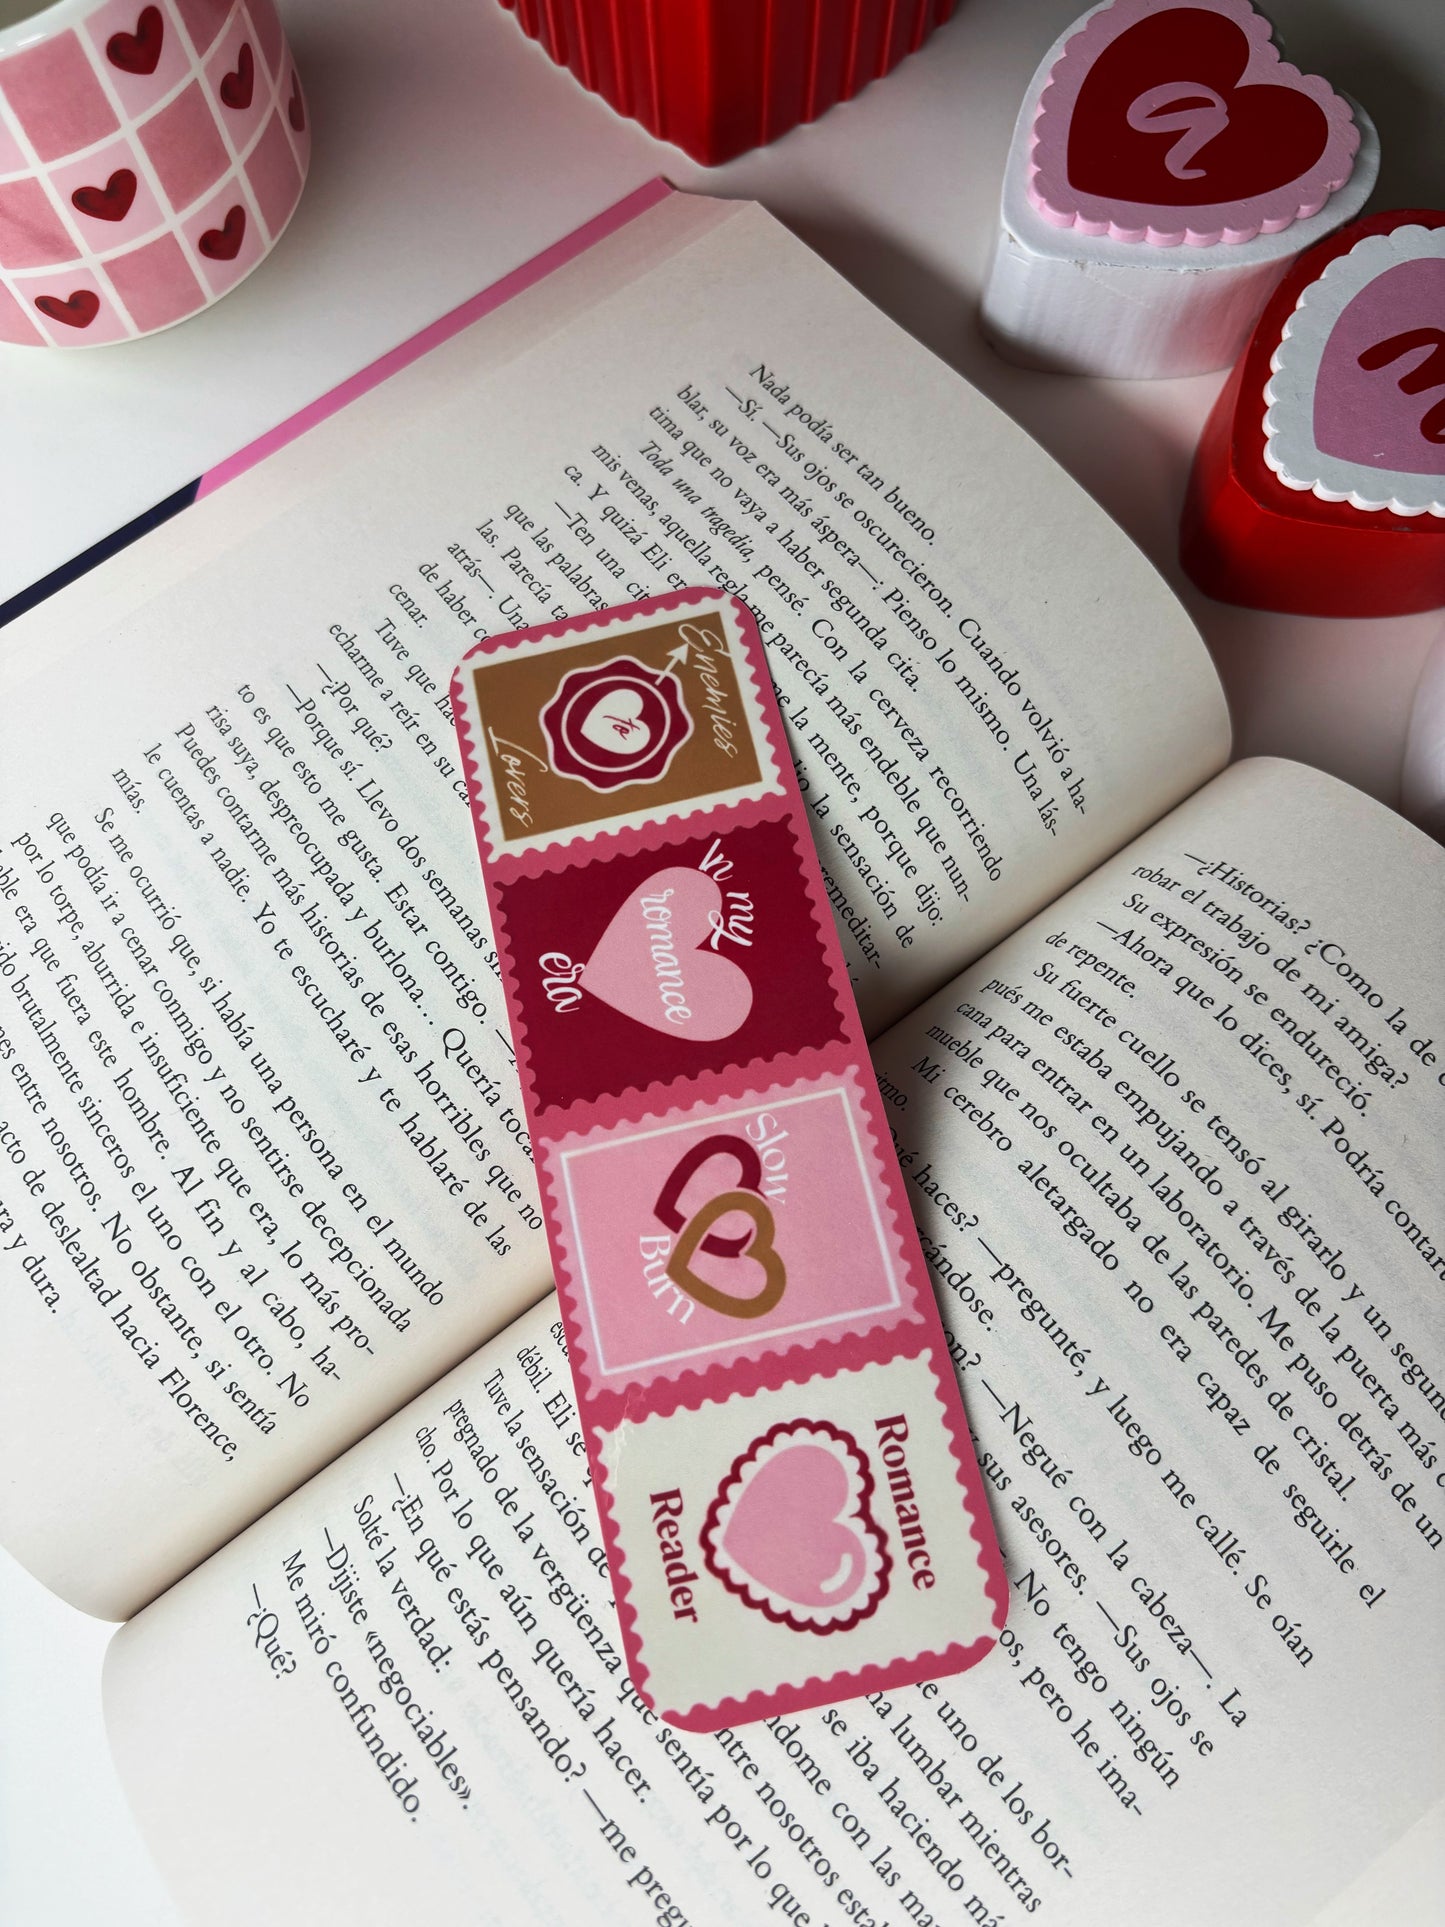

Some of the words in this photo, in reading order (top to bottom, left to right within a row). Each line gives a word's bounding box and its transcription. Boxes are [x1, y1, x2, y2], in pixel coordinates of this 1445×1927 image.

[1126, 81, 1230, 180] a
[747, 364, 791, 407] Nada
[782, 403, 833, 445] podía
[830, 442, 859, 466] ser
[855, 464, 885, 493] tan
[882, 485, 935, 547] bueno.
[387, 584, 428, 630] cenar.
[638, 440, 674, 478] Toda
[670, 478, 702, 506] una
[699, 506, 755, 565] tragedia,
[750, 564, 810, 618] pensé.
[810, 618, 848, 664] Con
[846, 659, 867, 686] la
[867, 689, 929, 764] cerveza
[927, 765, 1003, 883] recorriendo
[677, 623, 738, 758] Enemies
[724, 386, 763, 423] —Sí.
[761, 421, 806, 464] —Sus
[802, 462, 838, 494] ojos
[832, 491, 855, 510] se
[852, 510, 953, 620] oscurecieron.
[957, 618, 1021, 697] Cuando
[1020, 697, 1071, 765] volvió
[1059, 767, 1073, 783] a
[1066, 777, 1085, 816] ha-
[110, 768, 145, 815] mías.
[315, 663, 359, 717] —¿Por
[349, 717, 393, 754] qué?
[487, 726, 549, 828] Lovers
[602, 714, 640, 741] to
[285, 684, 344, 761] —Porque
[338, 760, 364, 783] sí.
[354, 778, 399, 833] Llevo
[395, 834, 427, 869] dos
[420, 869, 488, 951] semanas
[173, 722, 221, 786] Puedes
[215, 786, 277, 868] contarme
[270, 867, 306, 907] más
[298, 901, 364, 990] historias
[359, 991, 385, 1019] de
[381, 1021, 418, 1065] esas
[412, 1060, 491, 1163] horribles
[483, 1165, 522, 1204] que
[516, 1203, 543, 1231] no
[538, 952, 586, 1014] era
[639, 888, 692, 1026] romance
[707, 890, 755, 951] my
[1121, 893, 1150, 916] Su
[1148, 912, 1244, 986] expresión
[1242, 983, 1269, 1007] se
[1268, 1008, 1373, 1119] endureció.
[1129, 866, 1182, 893] robar
[1179, 889, 1207, 906] el
[1200, 901, 1271, 957] trabajo
[1271, 956, 1301, 984] de
[1299, 983, 1340, 1017] mi
[1332, 1016, 1409, 1091] amiga?
[1182, 853, 1311, 936] —¿Historias?
[1302, 939, 1384, 1010] ¿Como
[1383, 1006, 1407, 1037] la
[1408, 1038, 1436, 1068] de
[93, 807, 115, 834] Se
[107, 834, 134, 864] me
[128, 865, 182, 931] ocurrió
[167, 934, 201, 978] que,
[197, 976, 223, 997] si
[210, 990, 255, 1053] había
[249, 1051, 283, 1096] una
[270, 1095, 344, 1182] persona
[340, 1183, 368, 1215] en
[365, 1215, 394, 1239] el
[381, 1237, 444, 1307] mundo
[745, 1112, 789, 1204] Slow
[2, 1233, 28, 1252] y
[21, 1255, 60, 1315] dura.
[10, 1063, 47, 1115] entre
[40, 1117, 102, 1214] nosotros.
[99, 1210, 132, 1256] No
[130, 1260, 203, 1361] obstante,
[203, 1360, 232, 1382] si
[221, 1381, 277, 1436] sentía
[21, 1169, 47, 1198] de
[40, 1201, 122, 1309] deslealtad
[109, 1304, 160, 1371] hacia
[156, 1366, 237, 1463] Florence,
[638, 1234, 696, 1325] Burn
[909, 1055, 946, 1086] Mi
[942, 1086, 1013, 1153] cerebro
[1016, 1159, 1119, 1272] aletargado
[1121, 1280, 1154, 1315] no
[1159, 1324, 1192, 1364] era
[1195, 1371, 1251, 1438] capaz
[1252, 1444, 1280, 1477] de
[1281, 1483, 1355, 1575] seguirle
[1357, 1584, 1387, 1610] el
[923, 1025, 984, 1070] mueble
[979, 1069, 1020, 1103] que
[1017, 1101, 1058, 1140] nos
[1056, 1140, 1142, 1235] ocultaba
[1141, 1234, 1170, 1266] de
[1166, 1260, 1199, 1301] las
[1188, 1300, 1269, 1390] paredes
[1266, 1390, 1294, 1423] de
[1291, 1425, 1356, 1503] cristal.
[515, 1345, 553, 1395] débil.
[541, 1389, 576, 1432] Eli
[564, 1431, 585, 1458] se
[281, 1549, 307, 1593] Me
[352, 1494, 389, 1552] Solté
[374, 1545, 397, 1579] la
[390, 1577, 453, 1675] verdad:
[648, 1486, 699, 1624] Reader
[874, 1412, 936, 1592] Romance
[980, 1379, 1074, 1490] —Negué
[1067, 1496, 1107, 1544] con
[1104, 1539, 1129, 1573] la
[1129, 1577, 1213, 1691] cabeza—.
[1217, 1687, 1247, 1729] La
[245, 1583, 297, 1681] —¿Qué?
[293, 1593, 337, 1656] miró
[323, 1527, 368, 1626] —Dijiste
[364, 1631, 471, 1811] «negociables».
[390, 1472, 424, 1537] —¿En
[413, 1537, 458, 1584] qué
[446, 1587, 490, 1648] estás
[476, 1648, 587, 1784] pensando?
[582, 1788, 637, 1864] —me
[414, 1426, 437, 1465] cho.
[430, 1458, 460, 1504] Por
[450, 1498, 474, 1531] lo
[464, 1534, 504, 1581] que
[498, 1584, 537, 1637] aún
[530, 1638, 596, 1723] quería
[591, 1716, 651, 1805] hacer.
[1012, 1568, 1050, 1618] No
[1051, 1622, 1108, 1694] tengo
[1107, 1699, 1180, 1791] ningún
[324, 1661, 420, 1824] confundido.
[820, 1709, 847, 1738] se
[843, 1735, 879, 1783] iba
[876, 1776, 964, 1893] haciendo
[888, 1713, 963, 1810] lumbar
[957, 1810, 1042, 1914] mientras
[935, 1700, 978, 1753] uno
[975, 1754, 1005, 1788] de
[999, 1781, 1034, 1827] los
[1029, 1818, 1073, 1879] bor-
